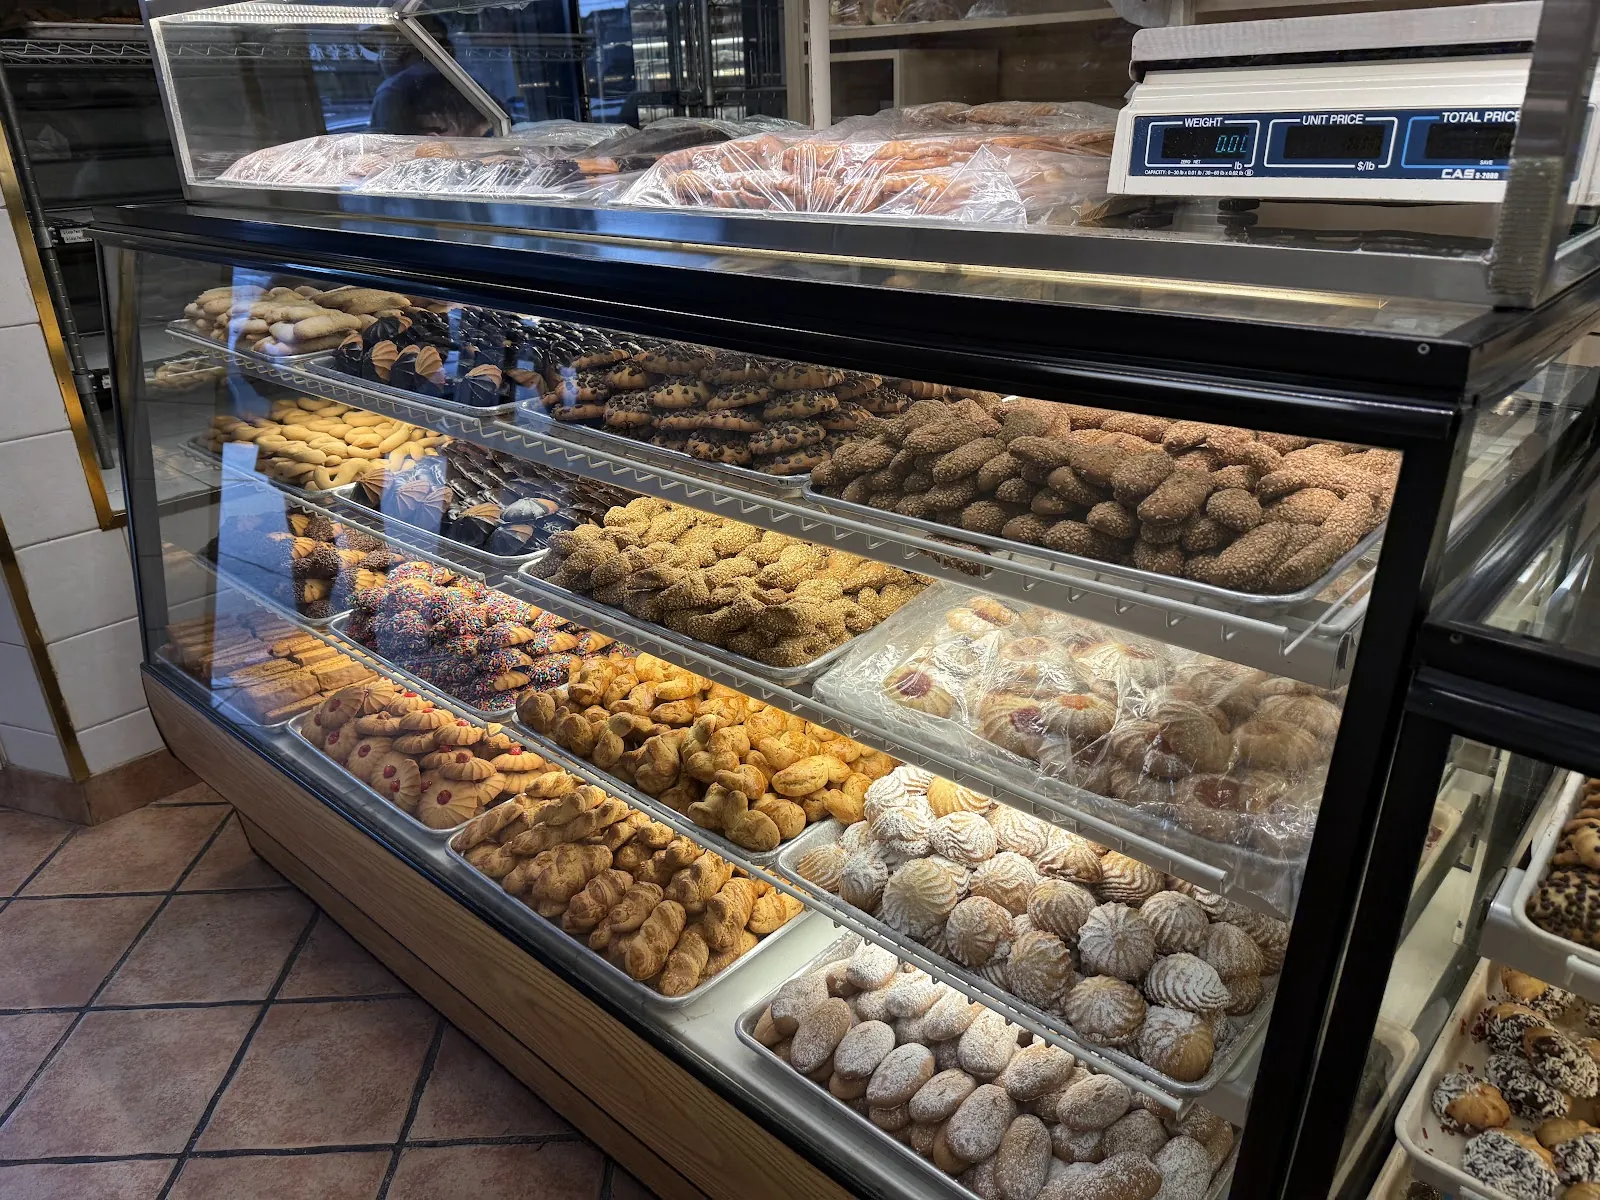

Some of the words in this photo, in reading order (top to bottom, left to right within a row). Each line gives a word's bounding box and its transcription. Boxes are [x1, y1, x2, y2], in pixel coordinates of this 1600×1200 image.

[1184, 117, 1223, 127] WEIGHT
[1302, 114, 1328, 125] UNIT
[1330, 114, 1364, 125] PRICE
[1442, 111, 1481, 123] TOTAL
[1234, 161, 1243, 170] lb
[1356, 161, 1375, 171] $/lb
[1441, 169, 1475, 179] CAS
